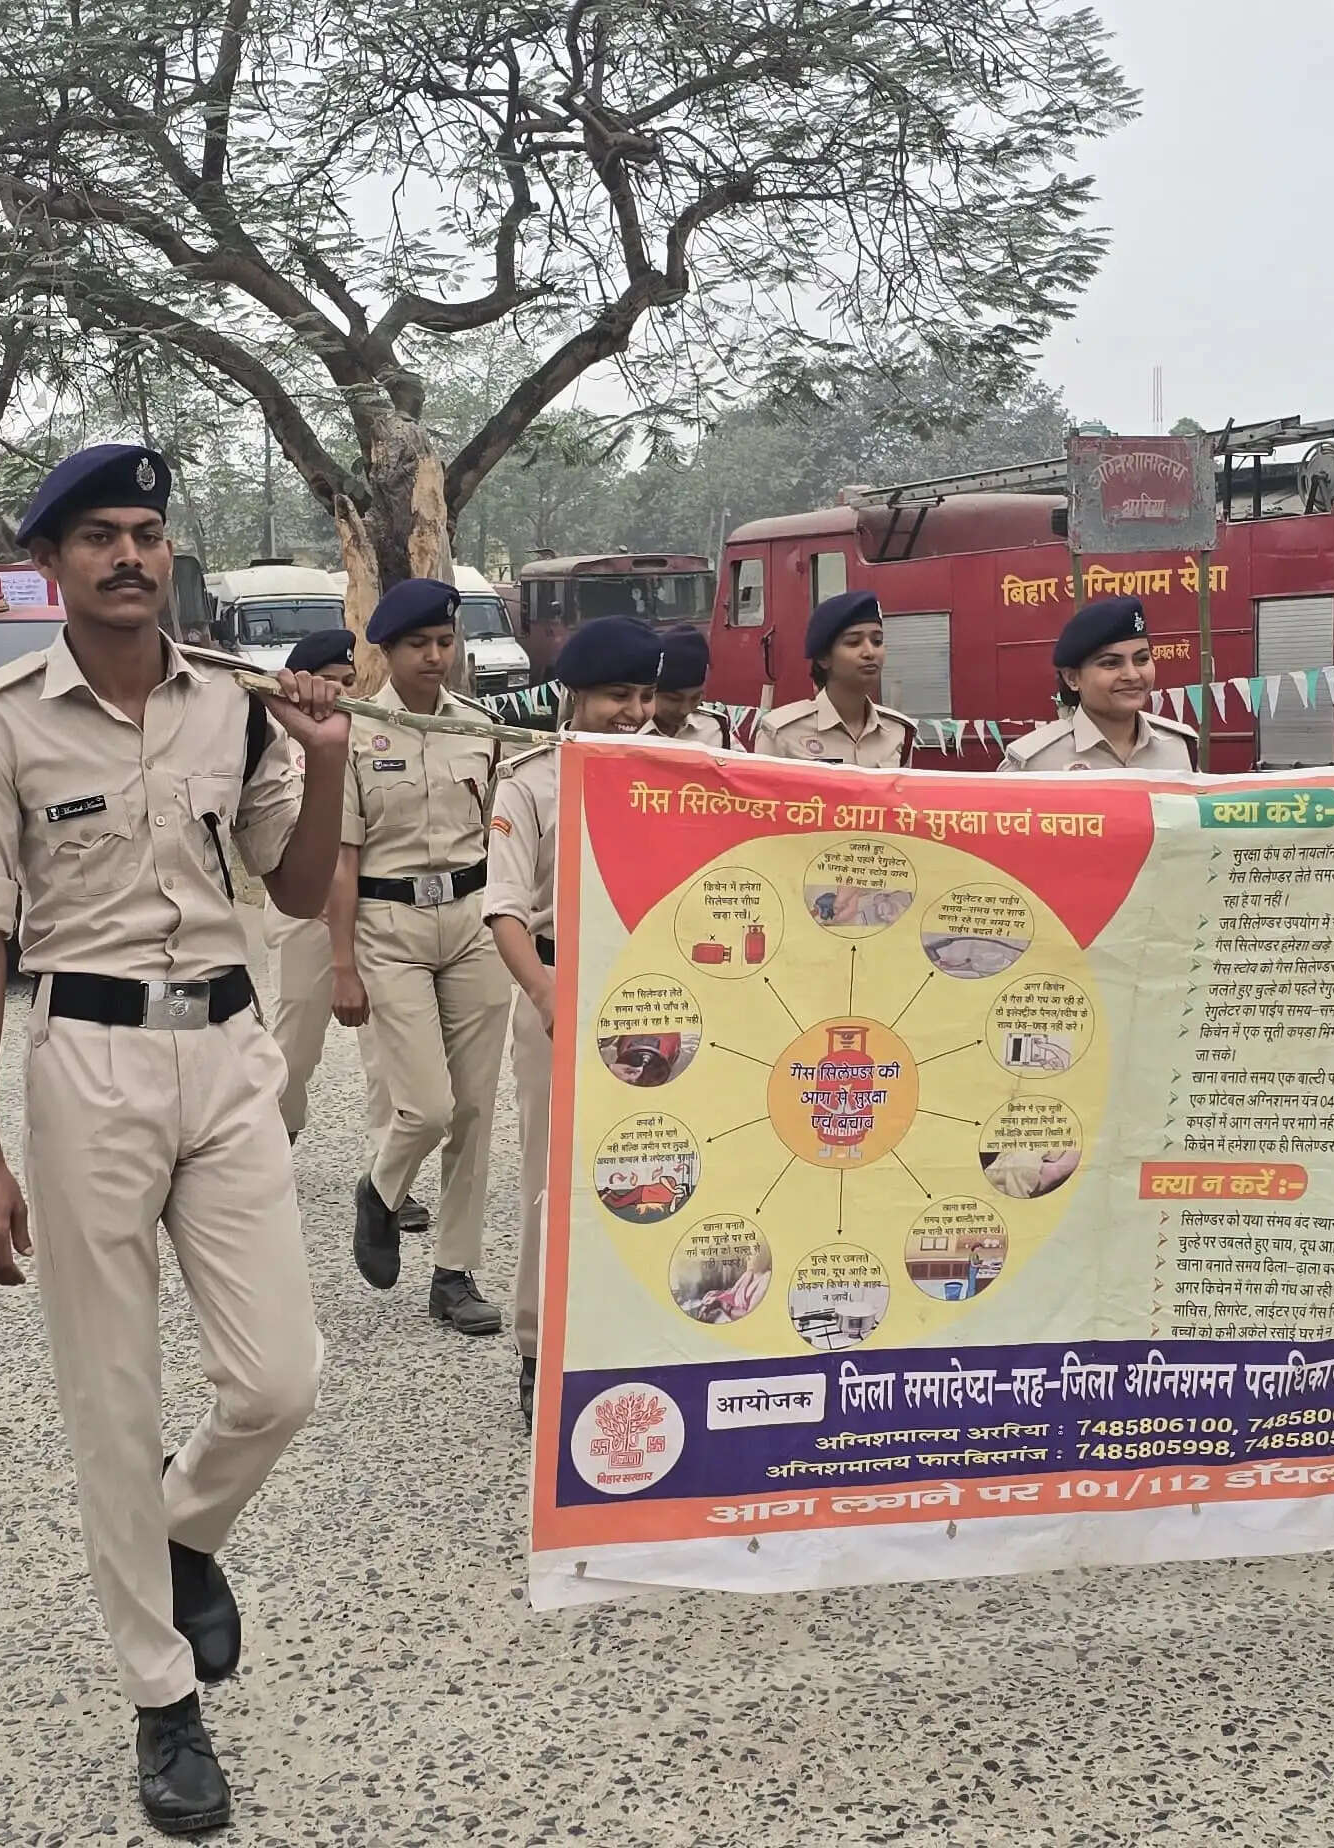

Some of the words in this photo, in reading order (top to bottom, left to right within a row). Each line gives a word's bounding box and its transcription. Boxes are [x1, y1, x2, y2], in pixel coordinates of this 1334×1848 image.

[1001, 574, 1060, 607] बिहार
[628, 781, 672, 815] गैस
[678, 782, 781, 822] सिलेण्डर
[784, 796, 827, 828] की
[833, 804, 887, 832] आग
[892, 802, 918, 832] से
[923, 809, 989, 841] सुरक्षा
[994, 807, 1033, 837] एवं
[1037, 813, 1106, 838] बचाव
[1211, 801, 1260, 824] क्या
[1265, 793, 1311, 824] करें
[1233, 846, 1261, 867] सुरक्षा
[1283, 843, 1296, 861] को
[790, 1062, 816, 1081] गैस
[820, 1062, 875, 1081] सिलेण्डर
[878, 1061, 901, 1080] की
[1192, 1071, 1218, 1085] खाना
[1250, 1071, 1275, 1084] समय
[1278, 1072, 1296, 1087] एक
[800, 1090, 832, 1105] आग
[836, 1088, 848, 1106] से
[853, 1090, 887, 1109] सुरक्षा
[1190, 1093, 1206, 1108] एक
[1247, 1090, 1299, 1108] अग्निशमन
[1320, 1096, 1334, 1109] 04
[811, 1114, 834, 1129] एवं
[837, 1115, 875, 1130] बचाव
[1184, 1134, 1215, 1153] किचेन
[1217, 1134, 1227, 1151] में
[1227, 1136, 1256, 1152] हमेशा
[1259, 1140, 1276, 1154] एक
[1278, 1135, 1289, 1154] ही
[1291, 1135, 1334, 1152] सिलेण्डर
[1152, 1175, 1198, 1195] क्या
[1202, 1176, 1224, 1195] न
[1230, 1168, 1276, 1196] करें
[1181, 1210, 1224, 1227] सिलेण्डर
[1227, 1210, 1240, 1227] को
[1242, 1214, 1263, 1227] यथा
[1266, 1211, 1291, 1228] संभव
[839, 1360, 895, 1417] जिला
[1125, 1349, 1237, 1401] अग्निशमन
[715, 1389, 814, 1415] आयोजक
[815, 1427, 958, 1452] अग्निशमालय
[966, 1421, 1050, 1445] अररिया
[1077, 1417, 1239, 1437] 7485806100,
[766, 1453, 915, 1479] अग्निशमालय
[918, 1444, 1048, 1472] फारबिसगंज
[1077, 1438, 1236, 1461] 7485805998,
[706, 1497, 819, 1524] आग
[831, 1482, 965, 1514] लगने
[977, 1482, 1044, 1505] पर
[1055, 1474, 1212, 1502] 101/112
